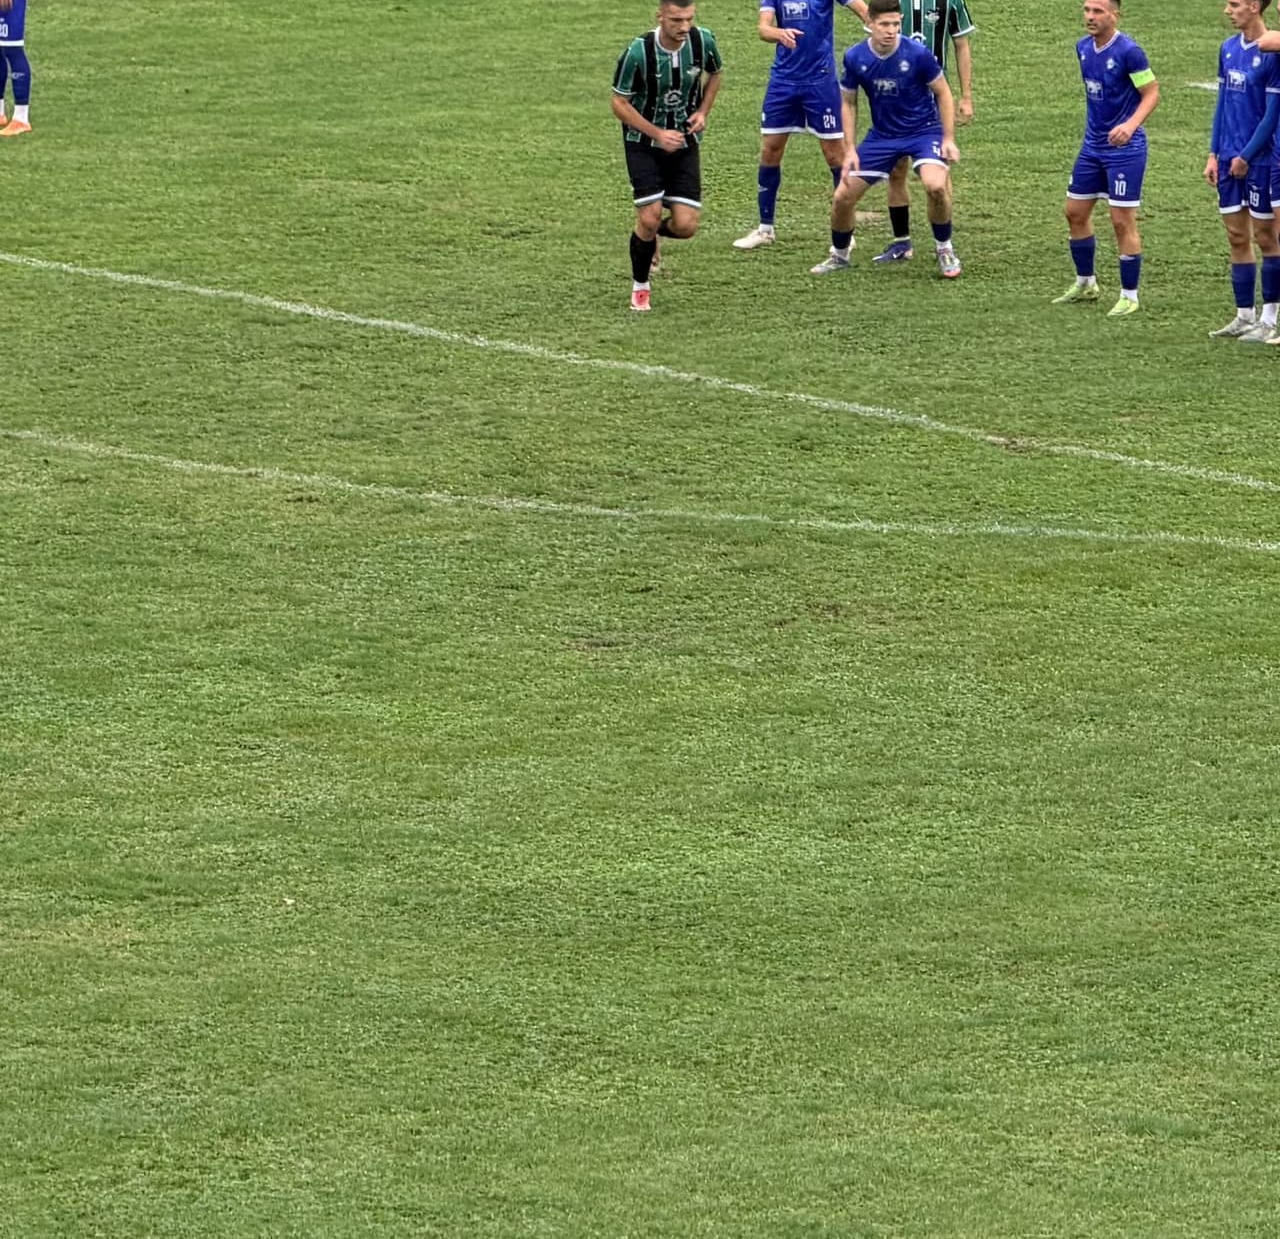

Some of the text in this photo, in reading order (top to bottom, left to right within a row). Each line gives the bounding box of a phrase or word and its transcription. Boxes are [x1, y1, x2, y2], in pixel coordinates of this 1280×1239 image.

[822, 114, 836, 129] 24
[1114, 180, 1127, 196] 10
[1249, 190, 1260, 208] 19
